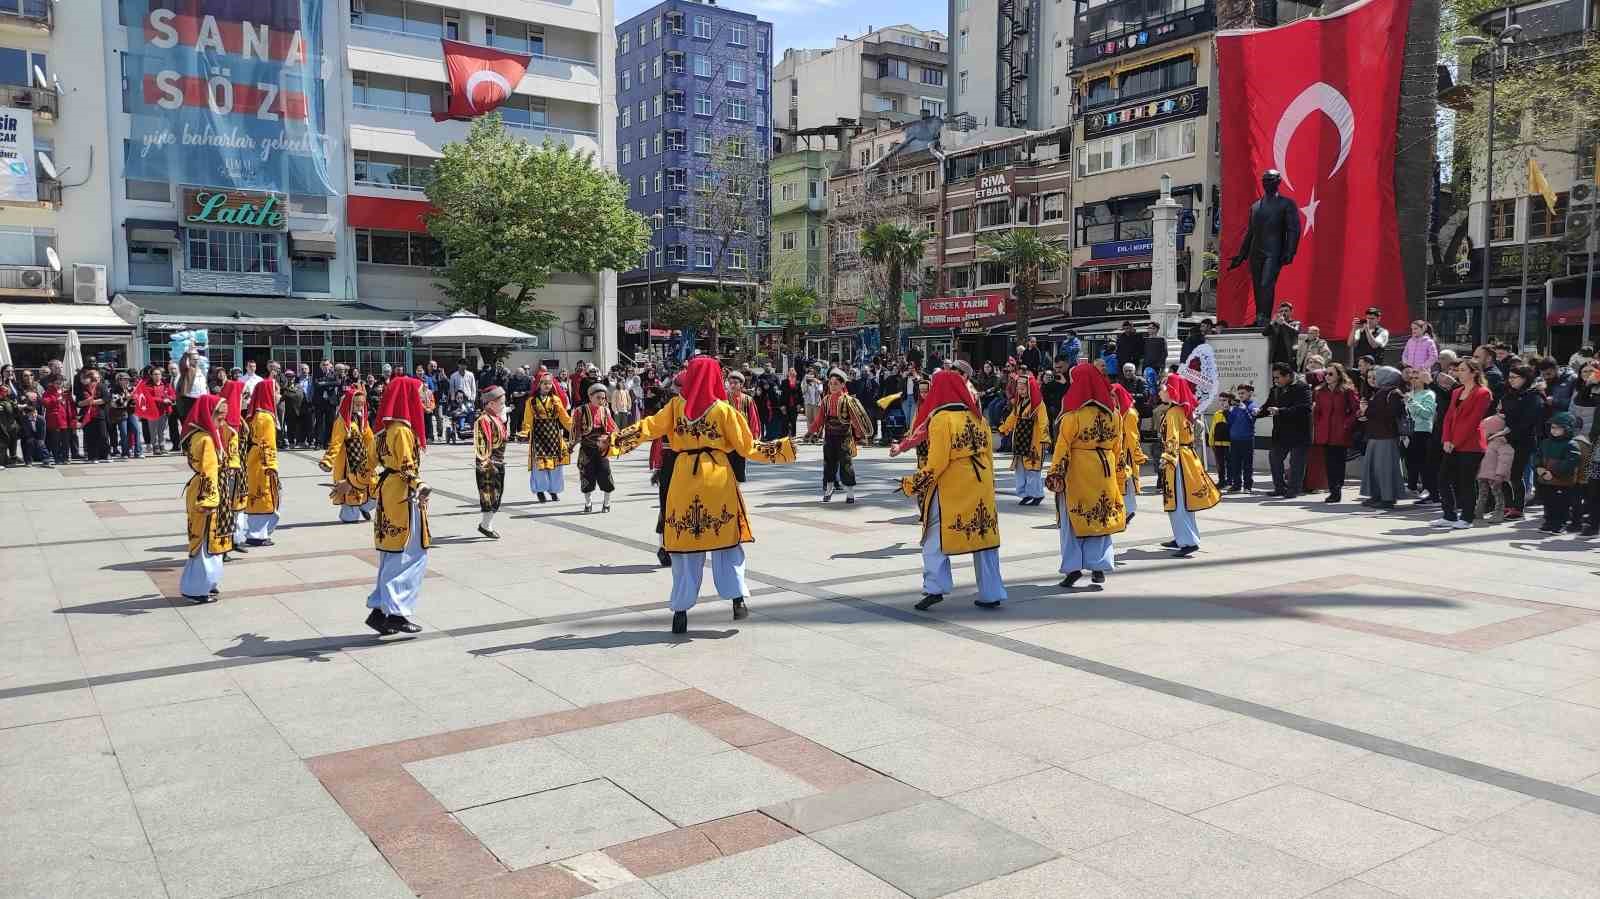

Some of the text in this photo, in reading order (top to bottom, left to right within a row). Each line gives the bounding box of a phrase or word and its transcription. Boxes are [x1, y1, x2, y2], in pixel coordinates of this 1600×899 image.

[150, 8, 306, 66] SANA
[156, 66, 280, 121] SÖZ
[140, 129, 176, 158] yine
[182, 123, 255, 148] baharlar
